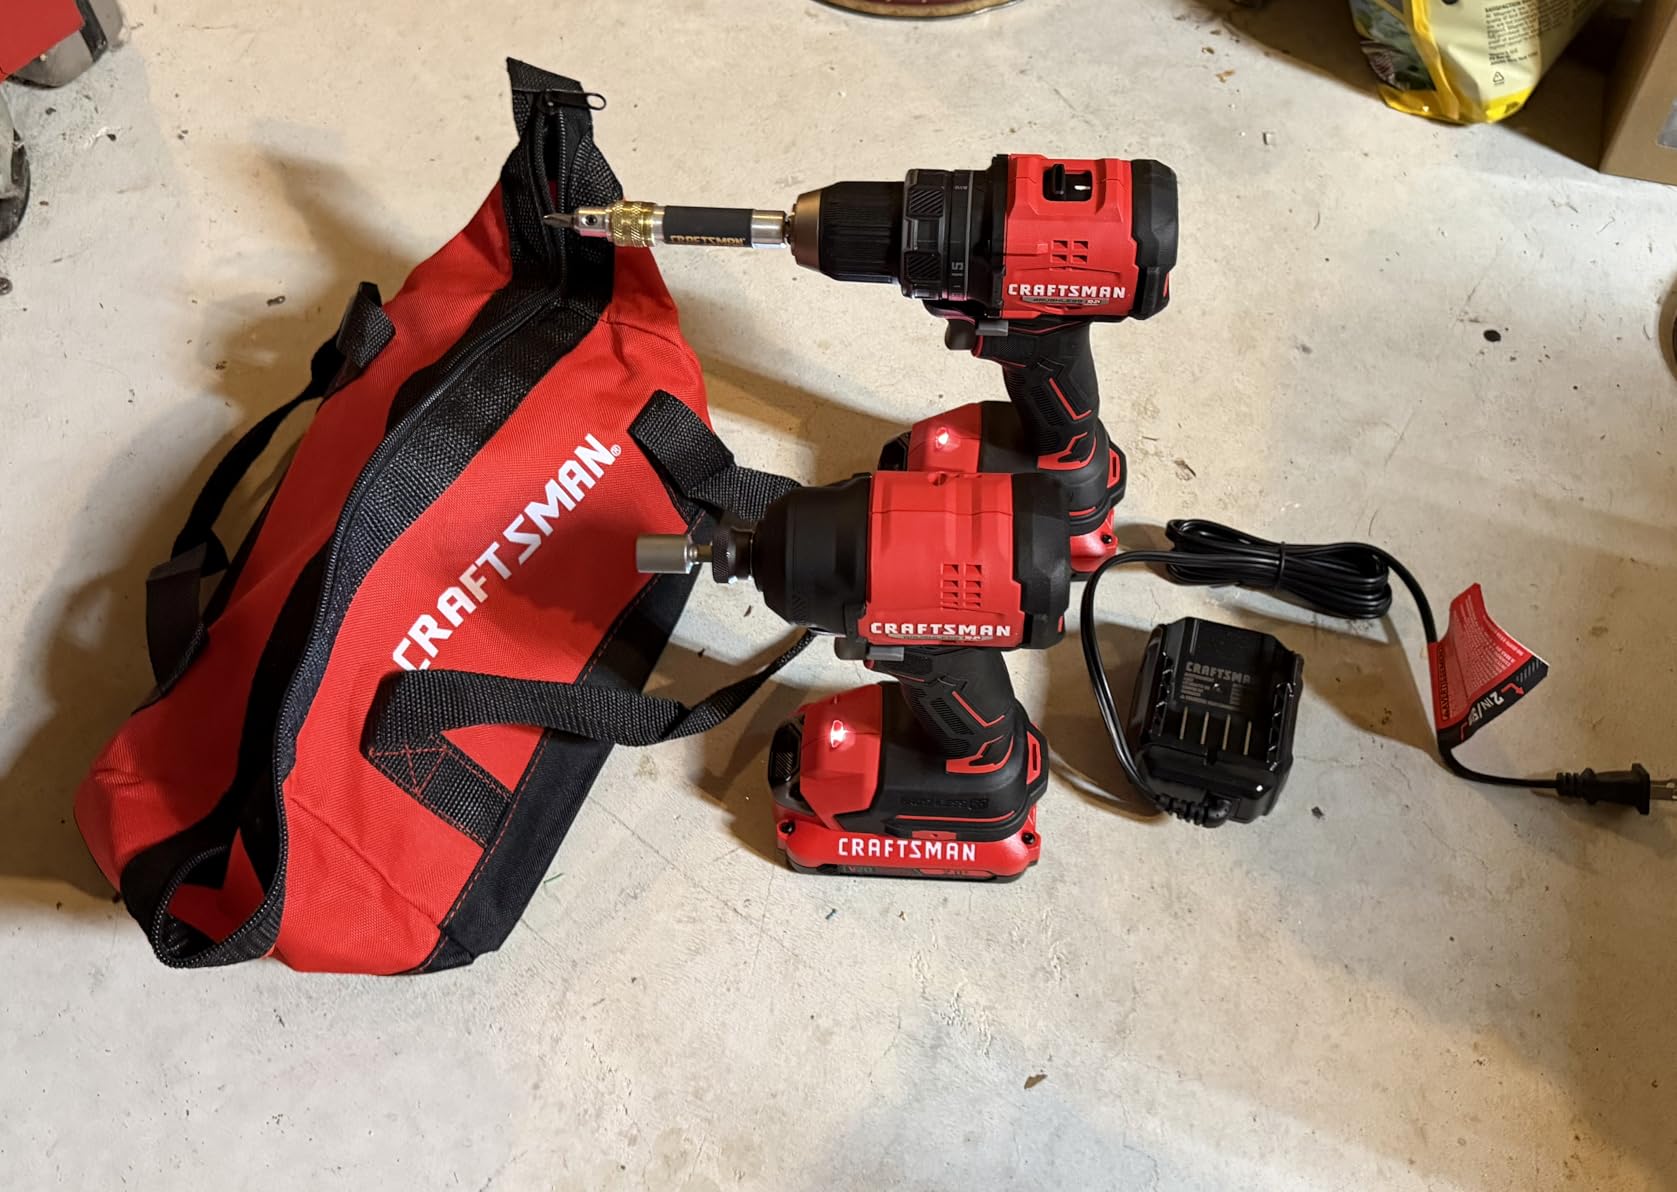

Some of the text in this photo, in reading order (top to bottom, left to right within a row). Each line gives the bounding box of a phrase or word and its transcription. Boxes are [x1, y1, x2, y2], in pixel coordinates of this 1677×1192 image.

[670, 235, 746, 247] CRAFTSMAN
[1008, 283, 1126, 299] CRAFTSMAN
[392, 433, 616, 671] CRAFTSMAN
[870, 622, 1011, 637] CRAFTSMAN
[1185, 661, 1252, 684] CRAFTSMA
[1490, 691, 1504, 706] 2
[838, 837, 976, 862] CRAFTSMAN
